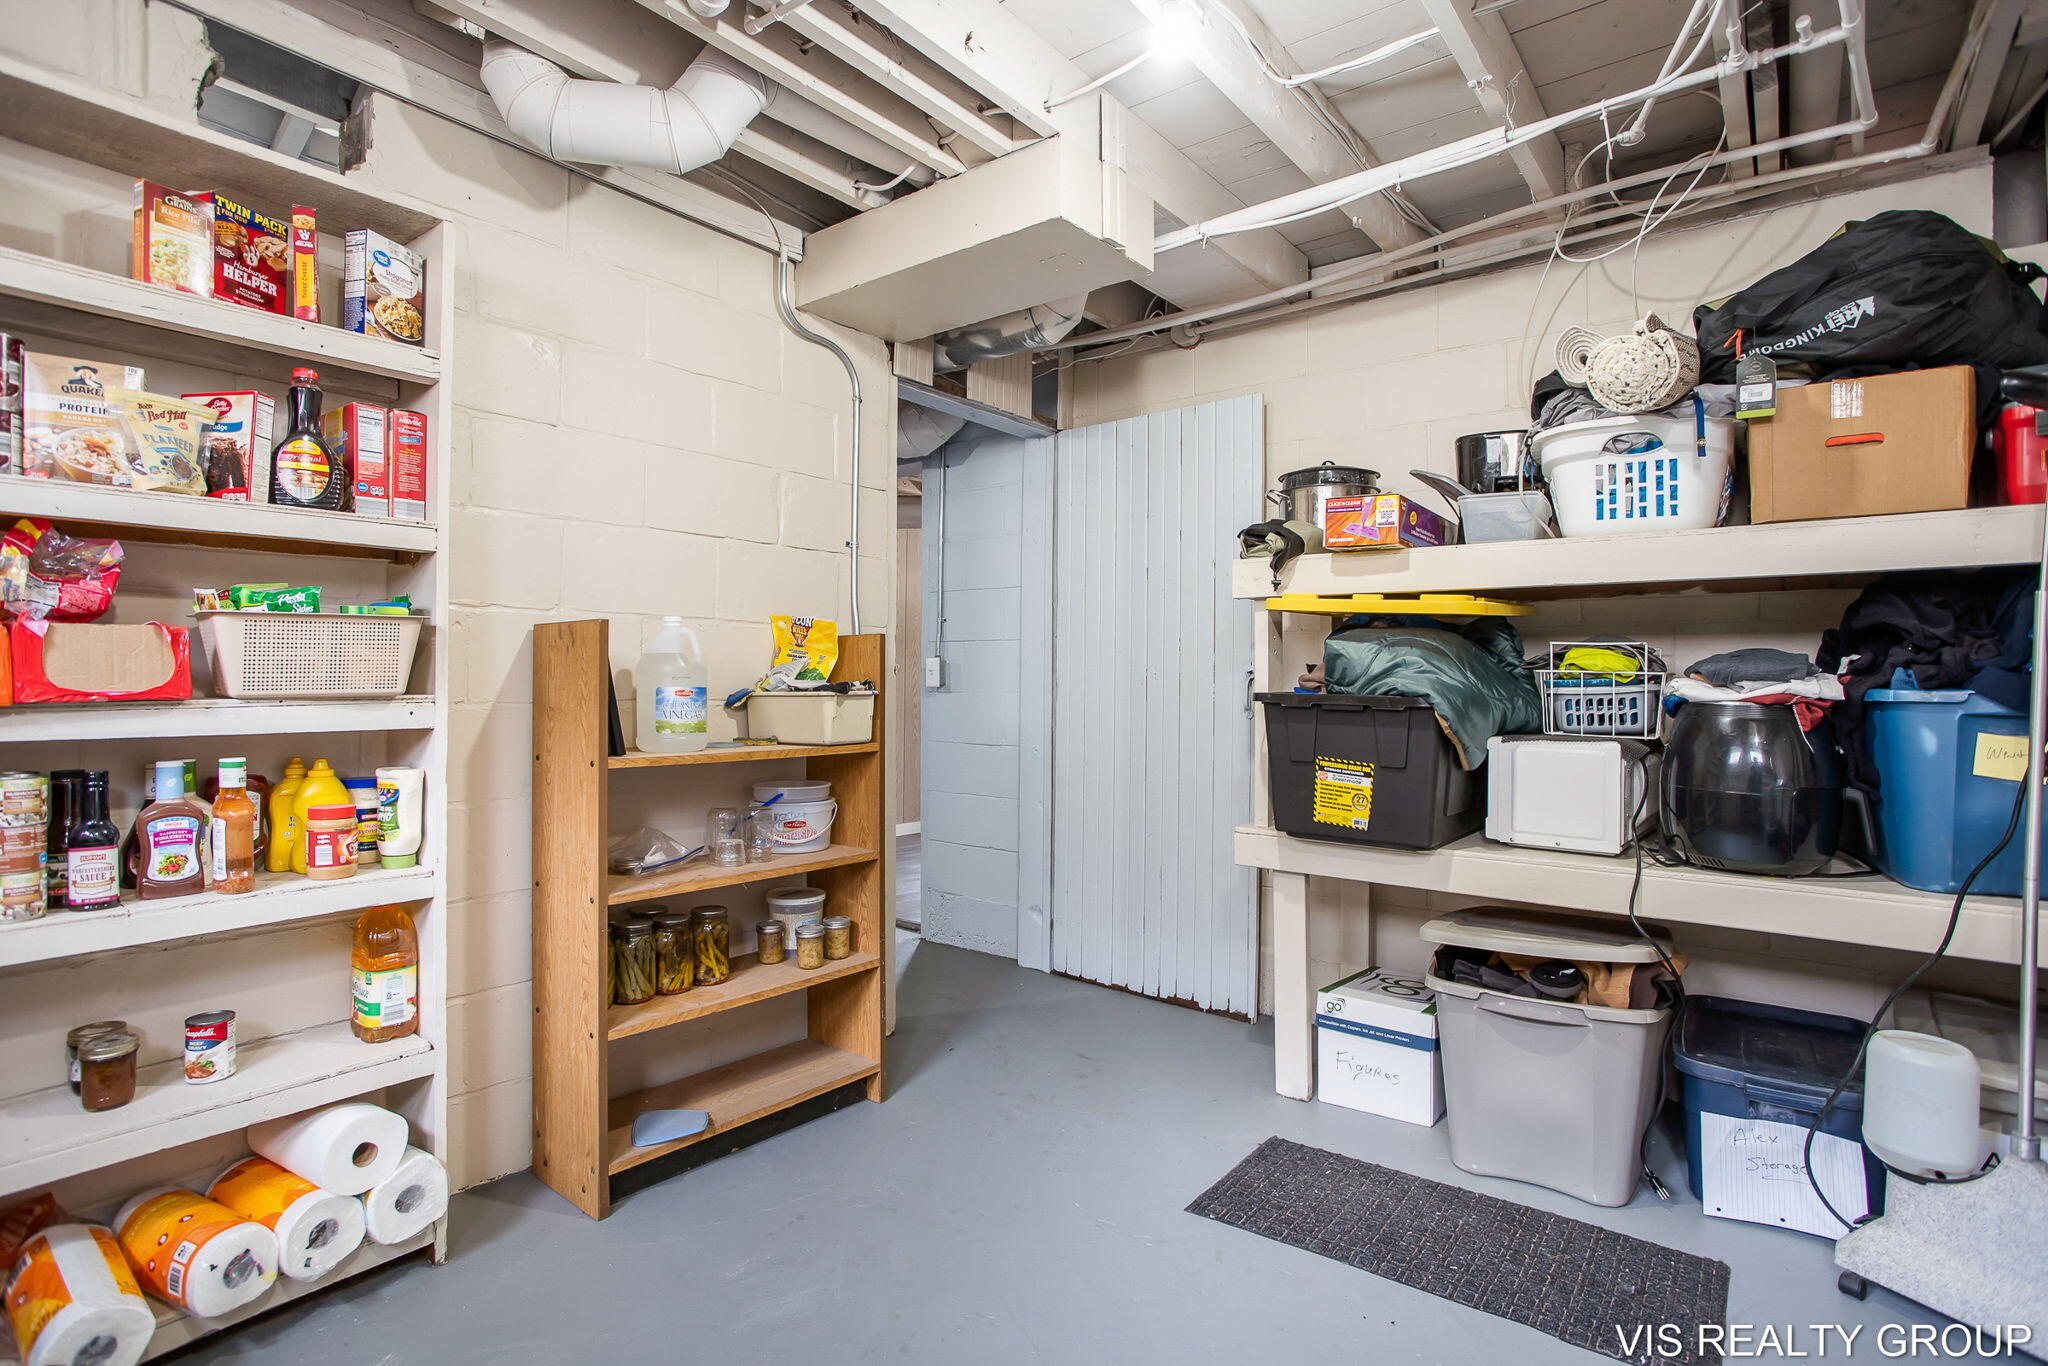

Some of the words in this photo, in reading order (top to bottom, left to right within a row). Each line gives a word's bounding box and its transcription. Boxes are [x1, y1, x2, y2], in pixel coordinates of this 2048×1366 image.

[214, 194, 251, 219] TWIN
[254, 212, 287, 235] PACK
[233, 260, 269, 280] Hamburger
[223, 262, 277, 296] HELPER
[147, 410, 165, 423] Red
[166, 410, 187, 423] Mill
[286, 453, 322, 462] Original
[277, 592, 305, 606] Pasta
[292, 603, 314, 613] Sides
[1356, 796, 1365, 804] 27
[80, 872, 107, 882] SAUCE
[1327, 1001, 1342, 1013] go
[1319, 1018, 1339, 1027] Compatible
[1732, 1127, 1778, 1146] Alex
[1746, 1156, 1808, 1175] Storage
